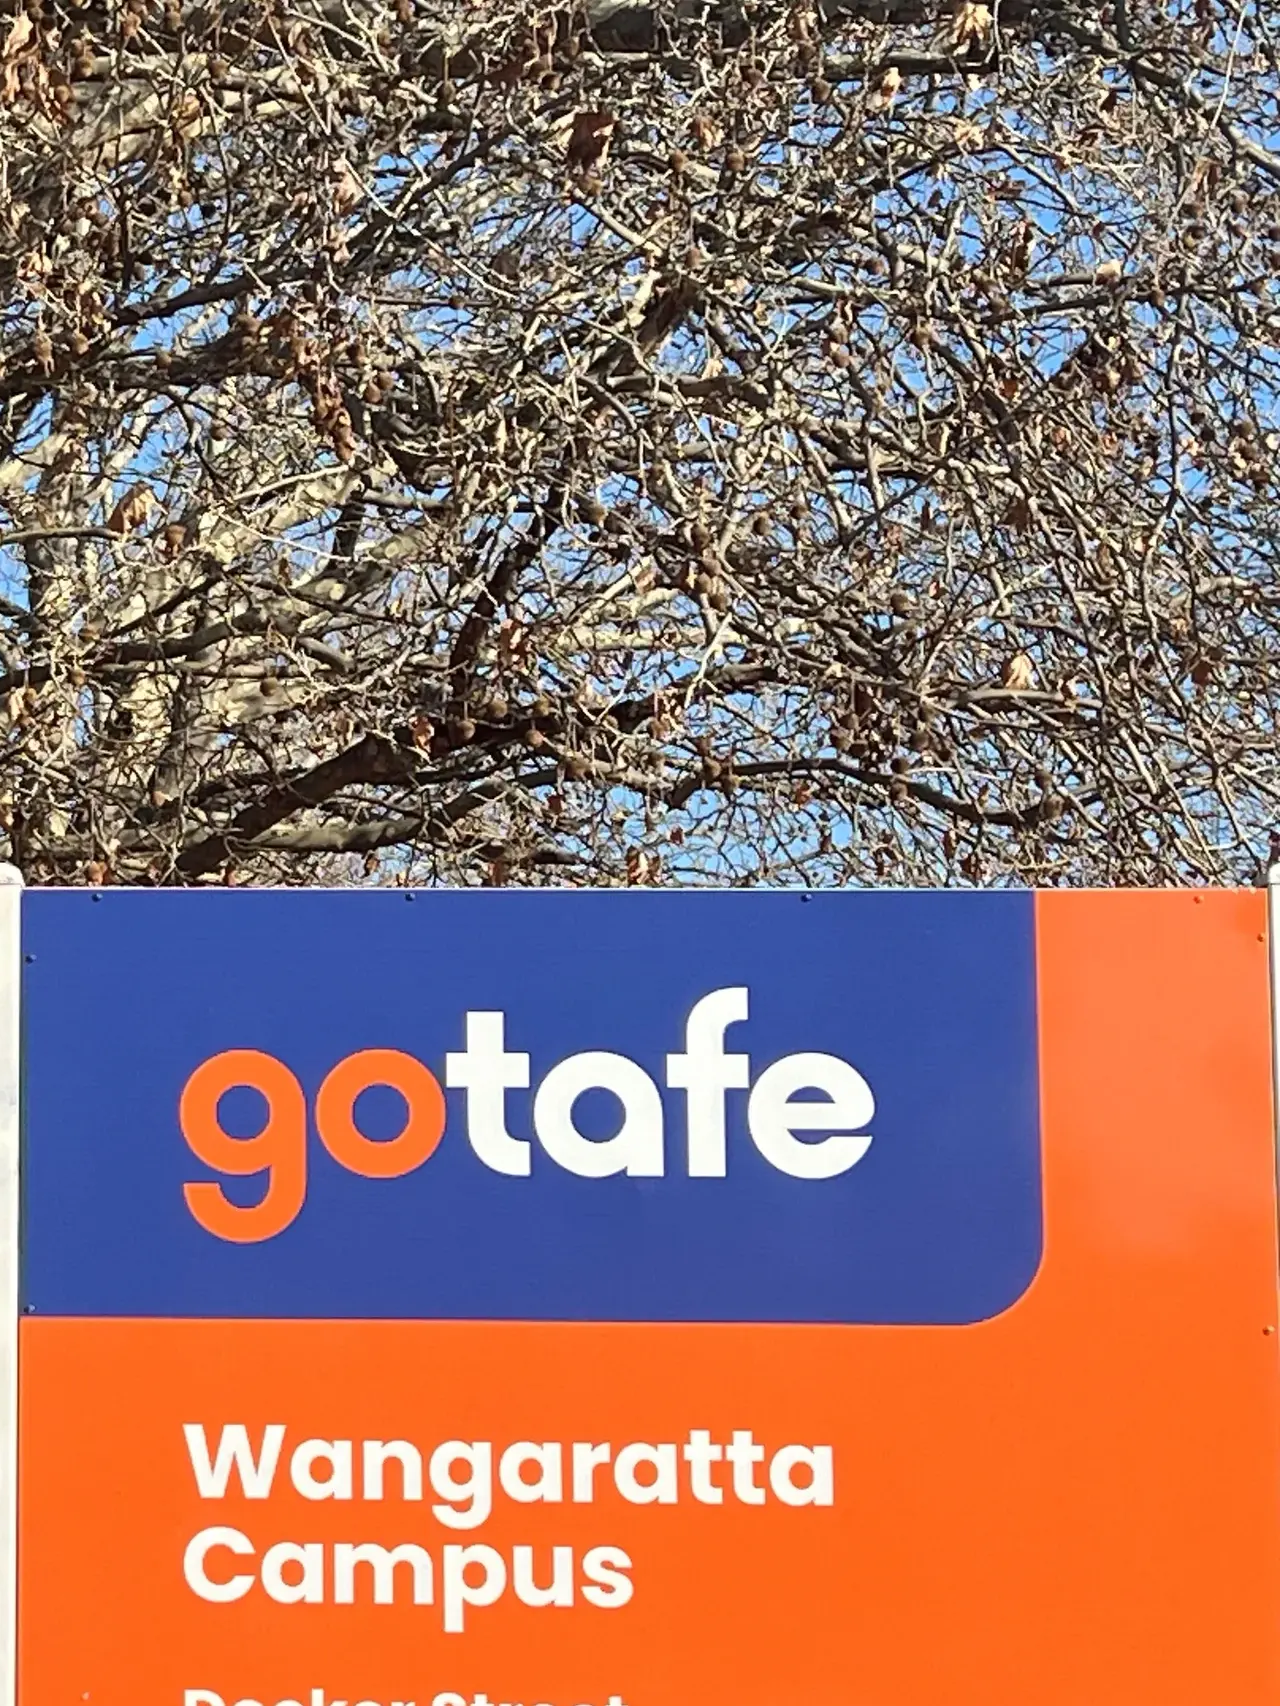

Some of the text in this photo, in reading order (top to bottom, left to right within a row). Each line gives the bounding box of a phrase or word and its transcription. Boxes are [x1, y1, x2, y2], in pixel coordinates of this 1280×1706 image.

[179, 987, 875, 1244] gotafe
[183, 1423, 834, 1530] Wangaratta
[183, 1526, 634, 1633] Campus
